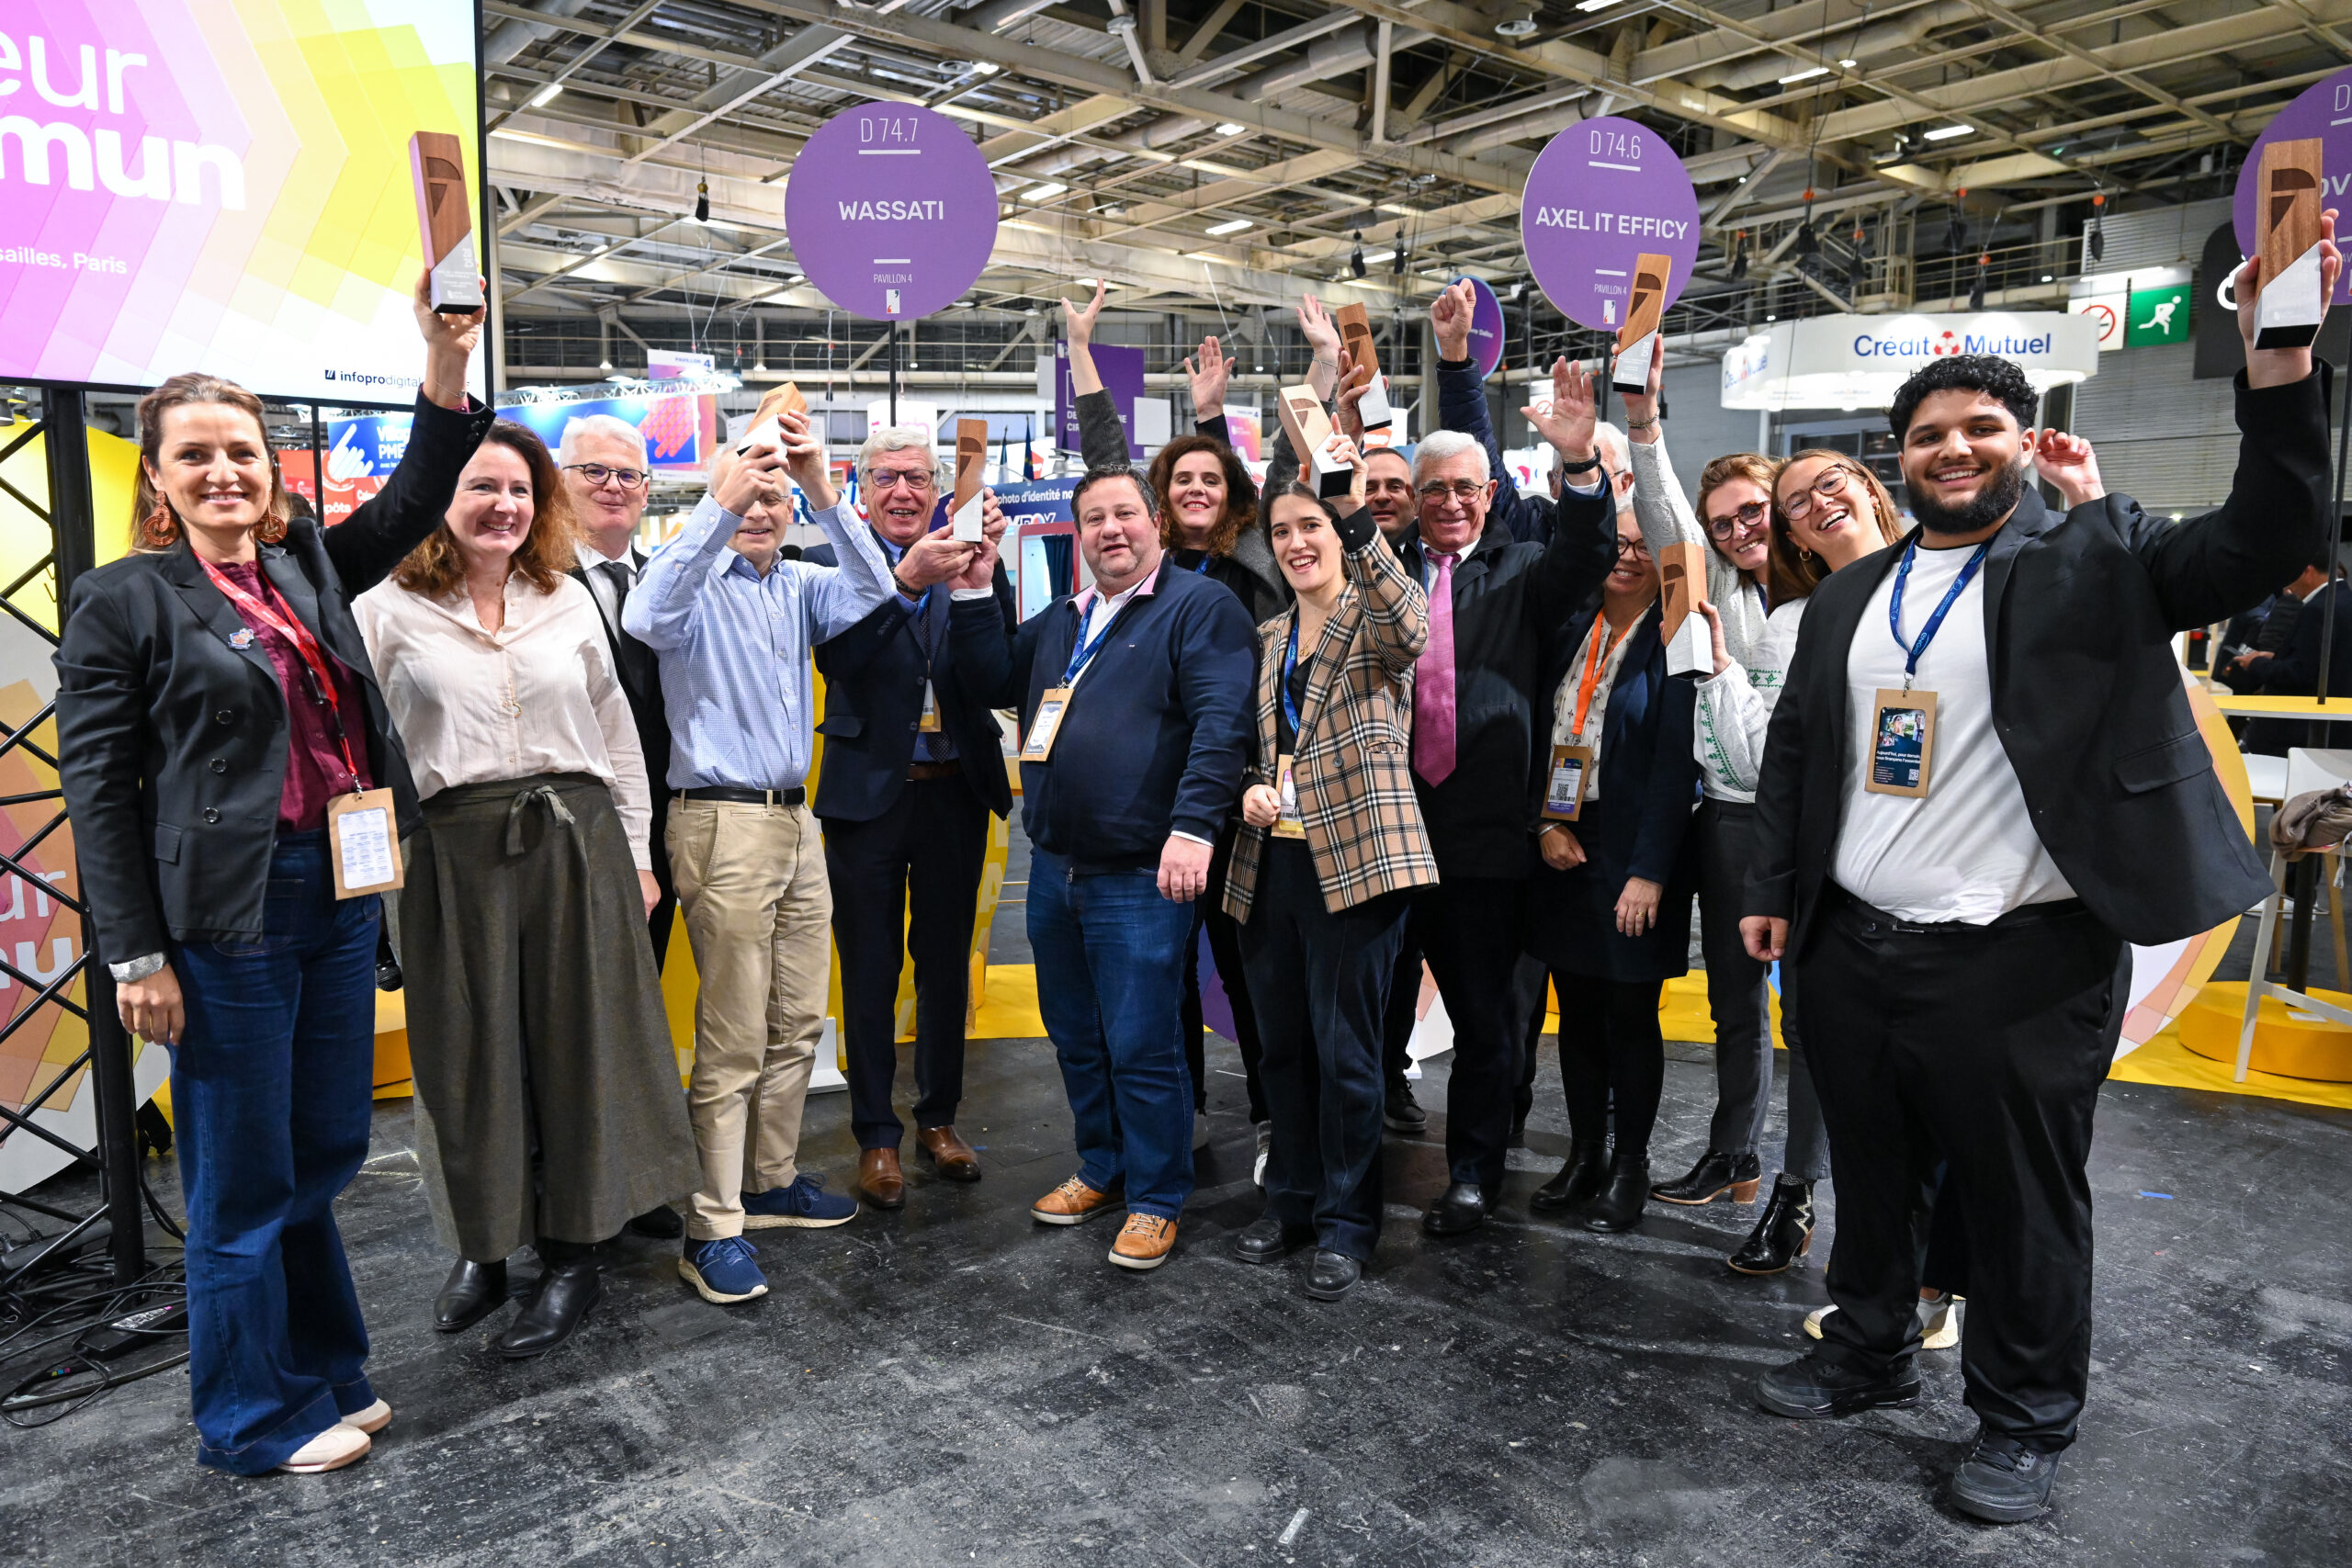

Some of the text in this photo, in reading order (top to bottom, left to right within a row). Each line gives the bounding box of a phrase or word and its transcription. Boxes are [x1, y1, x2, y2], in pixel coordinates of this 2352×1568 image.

[861, 118, 918, 142] D 74.7
[1590, 130, 1641, 160] D 74.6
[838, 200, 944, 220] WASSATI
[1535, 207, 1689, 240] AXEL IT EFFICY
[73, 252, 128, 274] Paris
[873, 274, 912, 284] PAVILLON 4
[1594, 283, 1627, 295] PAVILLON 4
[1854, 333, 2052, 356] Crédit Mutuel
[704, 359, 711, 368] 4
[998, 493, 1020, 507] photo
[1021, 488, 1061, 502] d'identité
